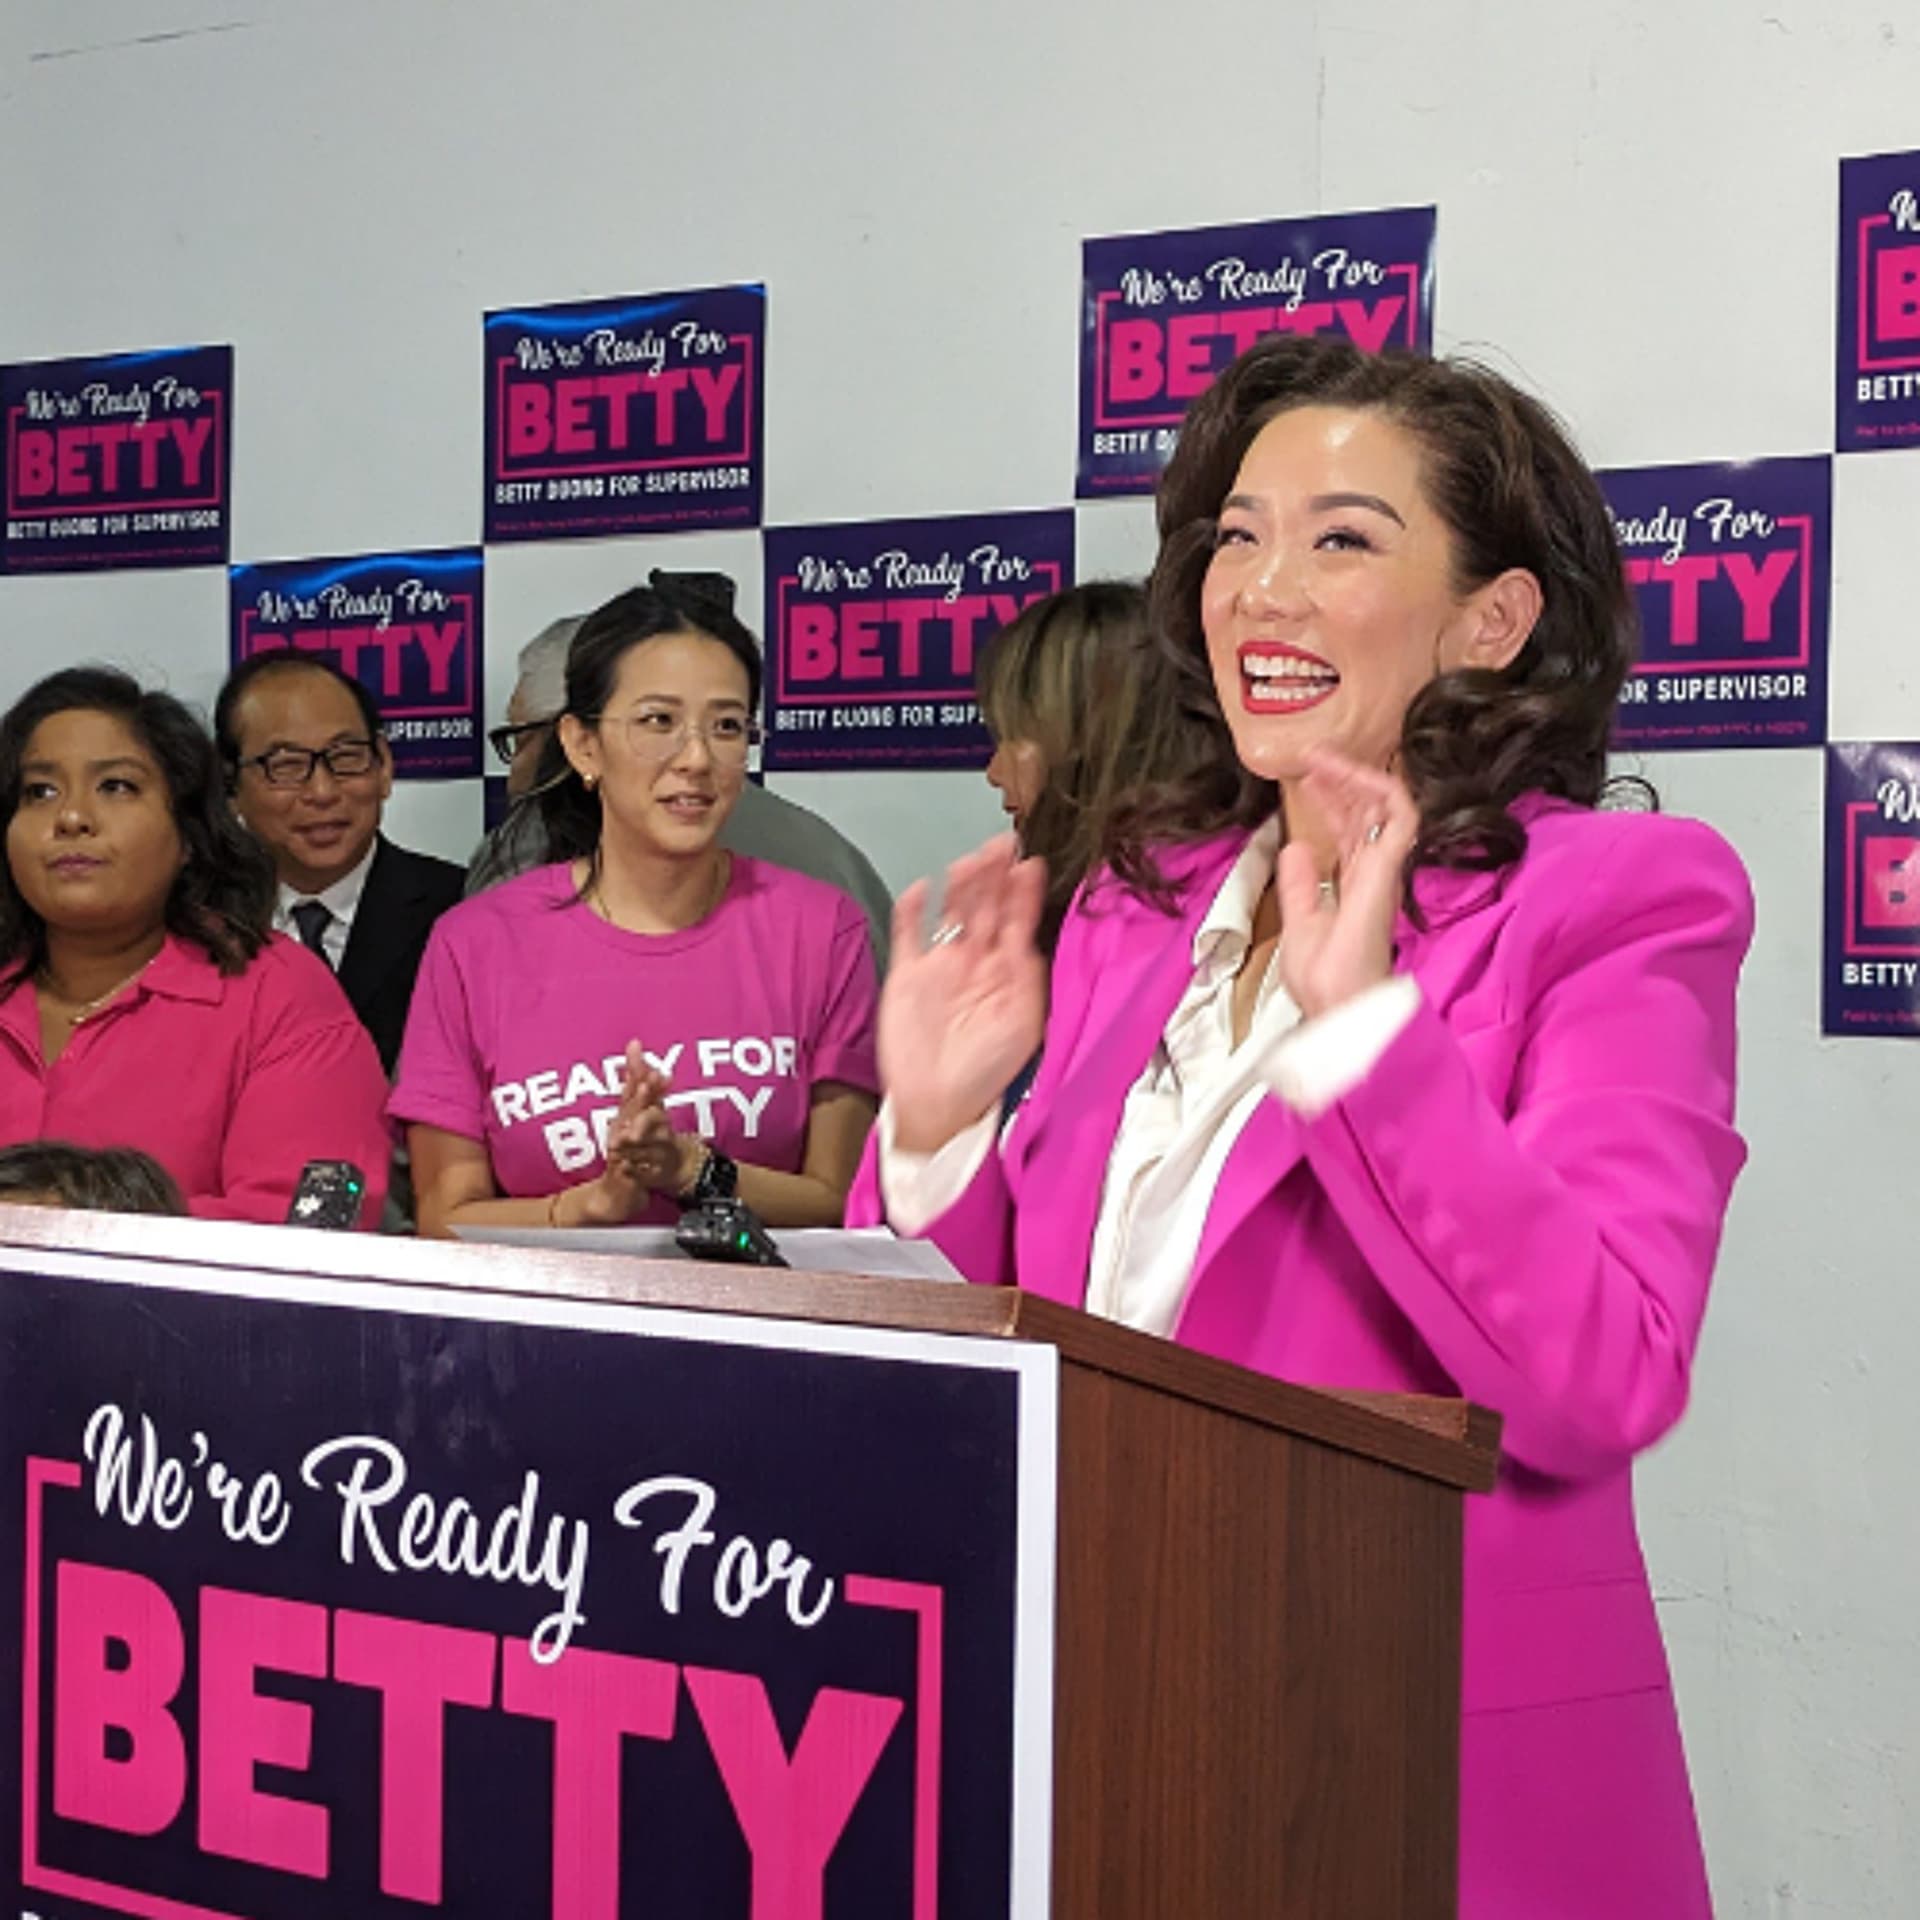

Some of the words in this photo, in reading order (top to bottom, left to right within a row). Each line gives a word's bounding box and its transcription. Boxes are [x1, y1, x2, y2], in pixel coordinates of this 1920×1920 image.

[1120, 268, 1203, 307] We're
[1205, 257, 1306, 313] Ready
[1312, 249, 1384, 290] For
[515, 338, 583, 369] We're
[584, 329, 665, 377] Ready
[671, 321, 727, 358] For
[81, 383, 151, 428] Ready
[153, 376, 201, 411] For
[508, 364, 742, 457] BETTY
[18, 417, 213, 496] BETTY
[1093, 430, 1149, 454] BETTY
[495, 481, 543, 504] BETTY
[610, 474, 640, 496] FOR
[645, 466, 750, 493] SUPERVISOR
[1604, 506, 1687, 565] eady
[1693, 498, 1775, 542] For
[798, 555, 872, 592] We're
[874, 549, 964, 604] Ready
[968, 543, 1031, 584] For
[257, 590, 320, 623] We're
[318, 583, 394, 633] Ready
[396, 579, 451, 614] For
[250, 621, 465, 697] TTY
[1657, 674, 1806, 703] SUPERVISOR
[775, 708, 827, 731] BETTY
[832, 706, 895, 728] DUONG
[900, 704, 934, 726] FOR
[1843, 963, 1919, 986] BETTY
[491, 1043, 684, 1127] READY
[697, 1036, 798, 1078] FOR
[543, 1086, 775, 1173] BTY
[83, 1402, 291, 1548] We're
[301, 1434, 592, 1665] Ready
[613, 1475, 834, 1628] For
[52, 1557, 906, 1920] BETTY
